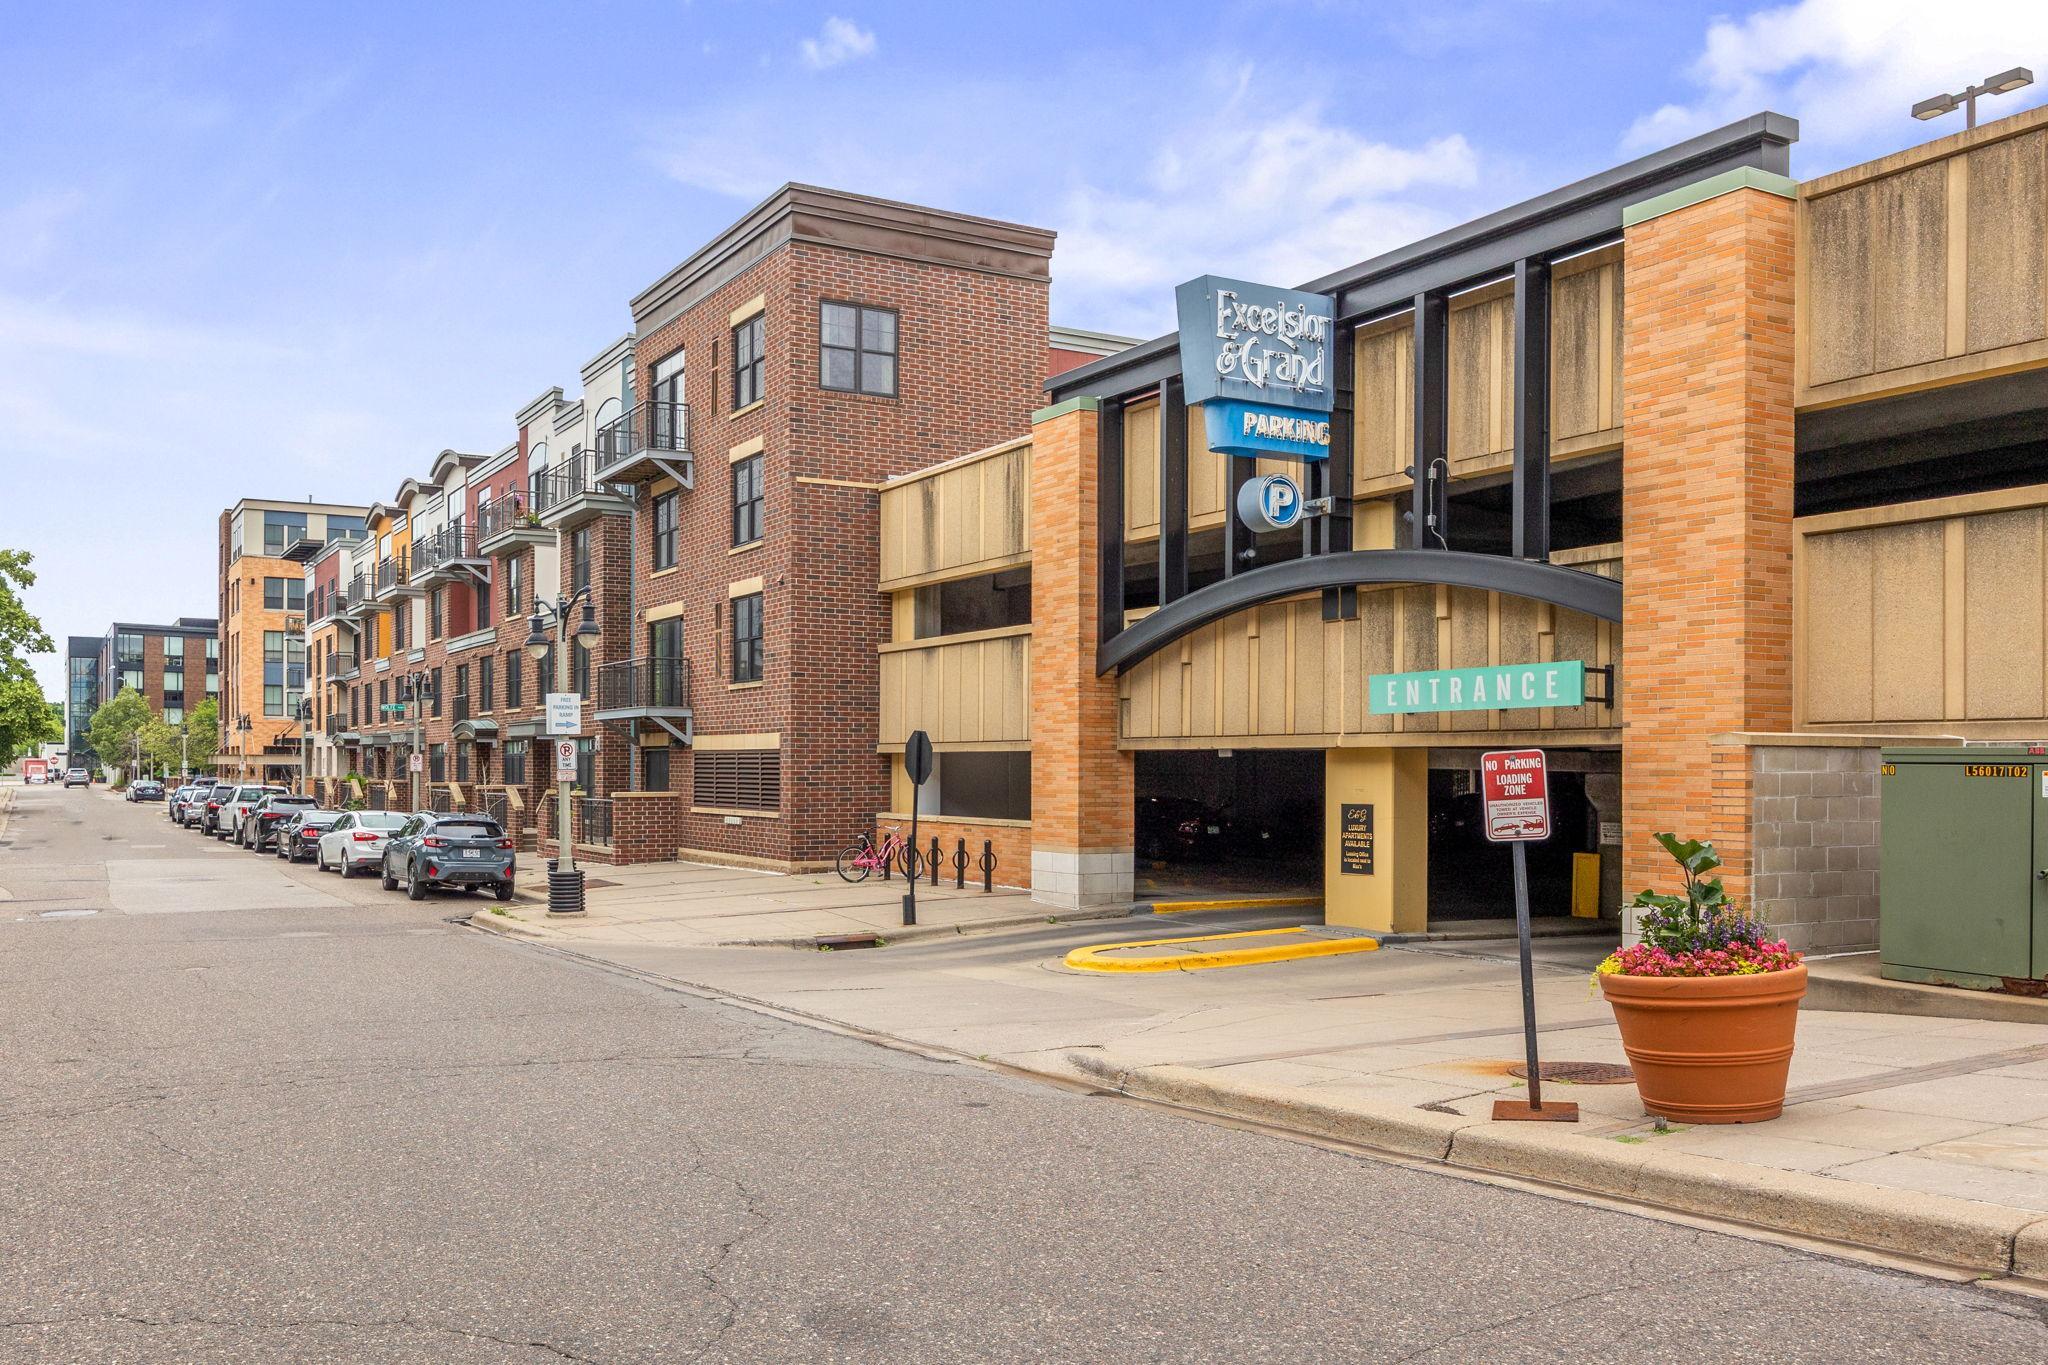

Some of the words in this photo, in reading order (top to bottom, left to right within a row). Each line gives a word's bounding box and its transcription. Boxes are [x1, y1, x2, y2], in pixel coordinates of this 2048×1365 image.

[1216, 289, 1332, 350] Excelsior
[1243, 412, 1331, 446] PARKING
[1386, 670, 1559, 706] ENTRANCE
[1485, 760, 1498, 771] NO
[1505, 758, 1541, 769] PARKING
[1496, 773, 1533, 785] LOADING
[1504, 785, 1526, 795] ZONE
